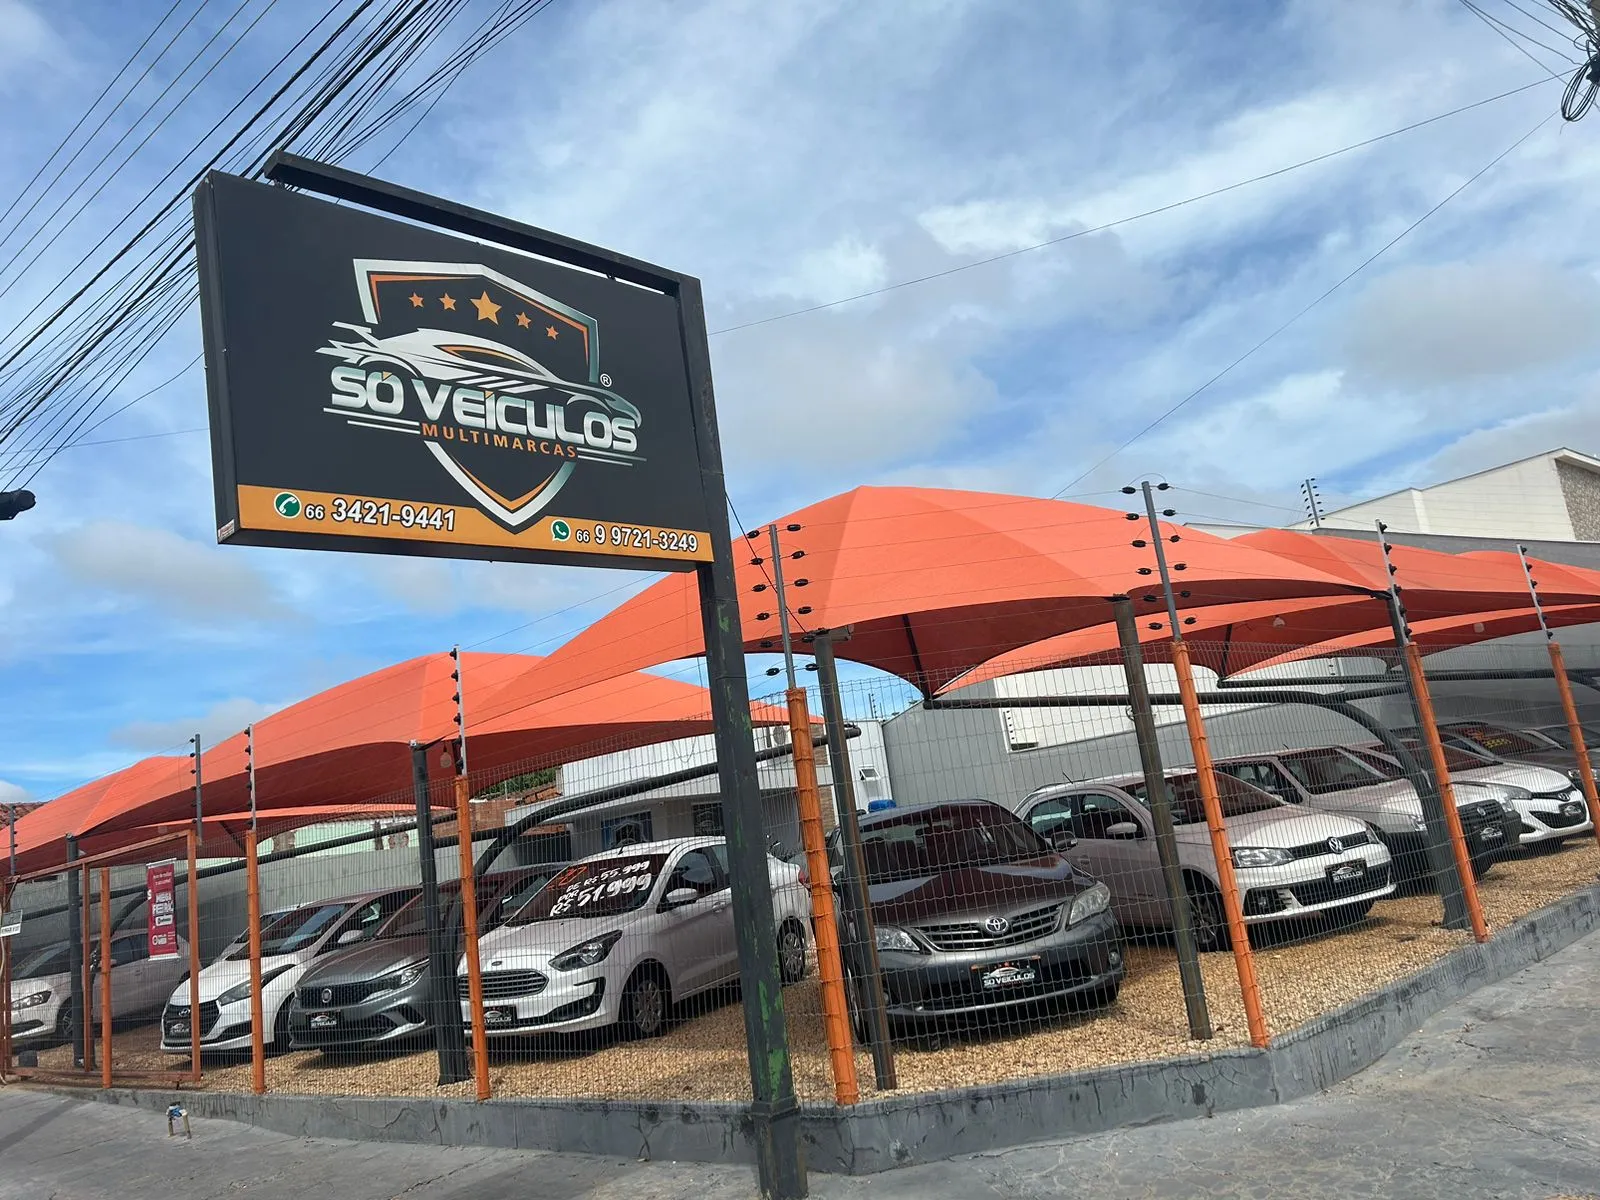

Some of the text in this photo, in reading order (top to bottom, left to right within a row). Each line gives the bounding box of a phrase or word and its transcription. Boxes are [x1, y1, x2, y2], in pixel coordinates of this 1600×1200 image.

[421, 422, 577, 458] MULTIMARCAS
[304, 498, 456, 531] 66 3421-9441
[575, 524, 698, 552] 66 9 9721-3249
[549, 898, 575, 917] R$
[578, 873, 652, 907] 51.999
[557, 889, 580, 904] POR
[566, 882, 581, 892] DE
